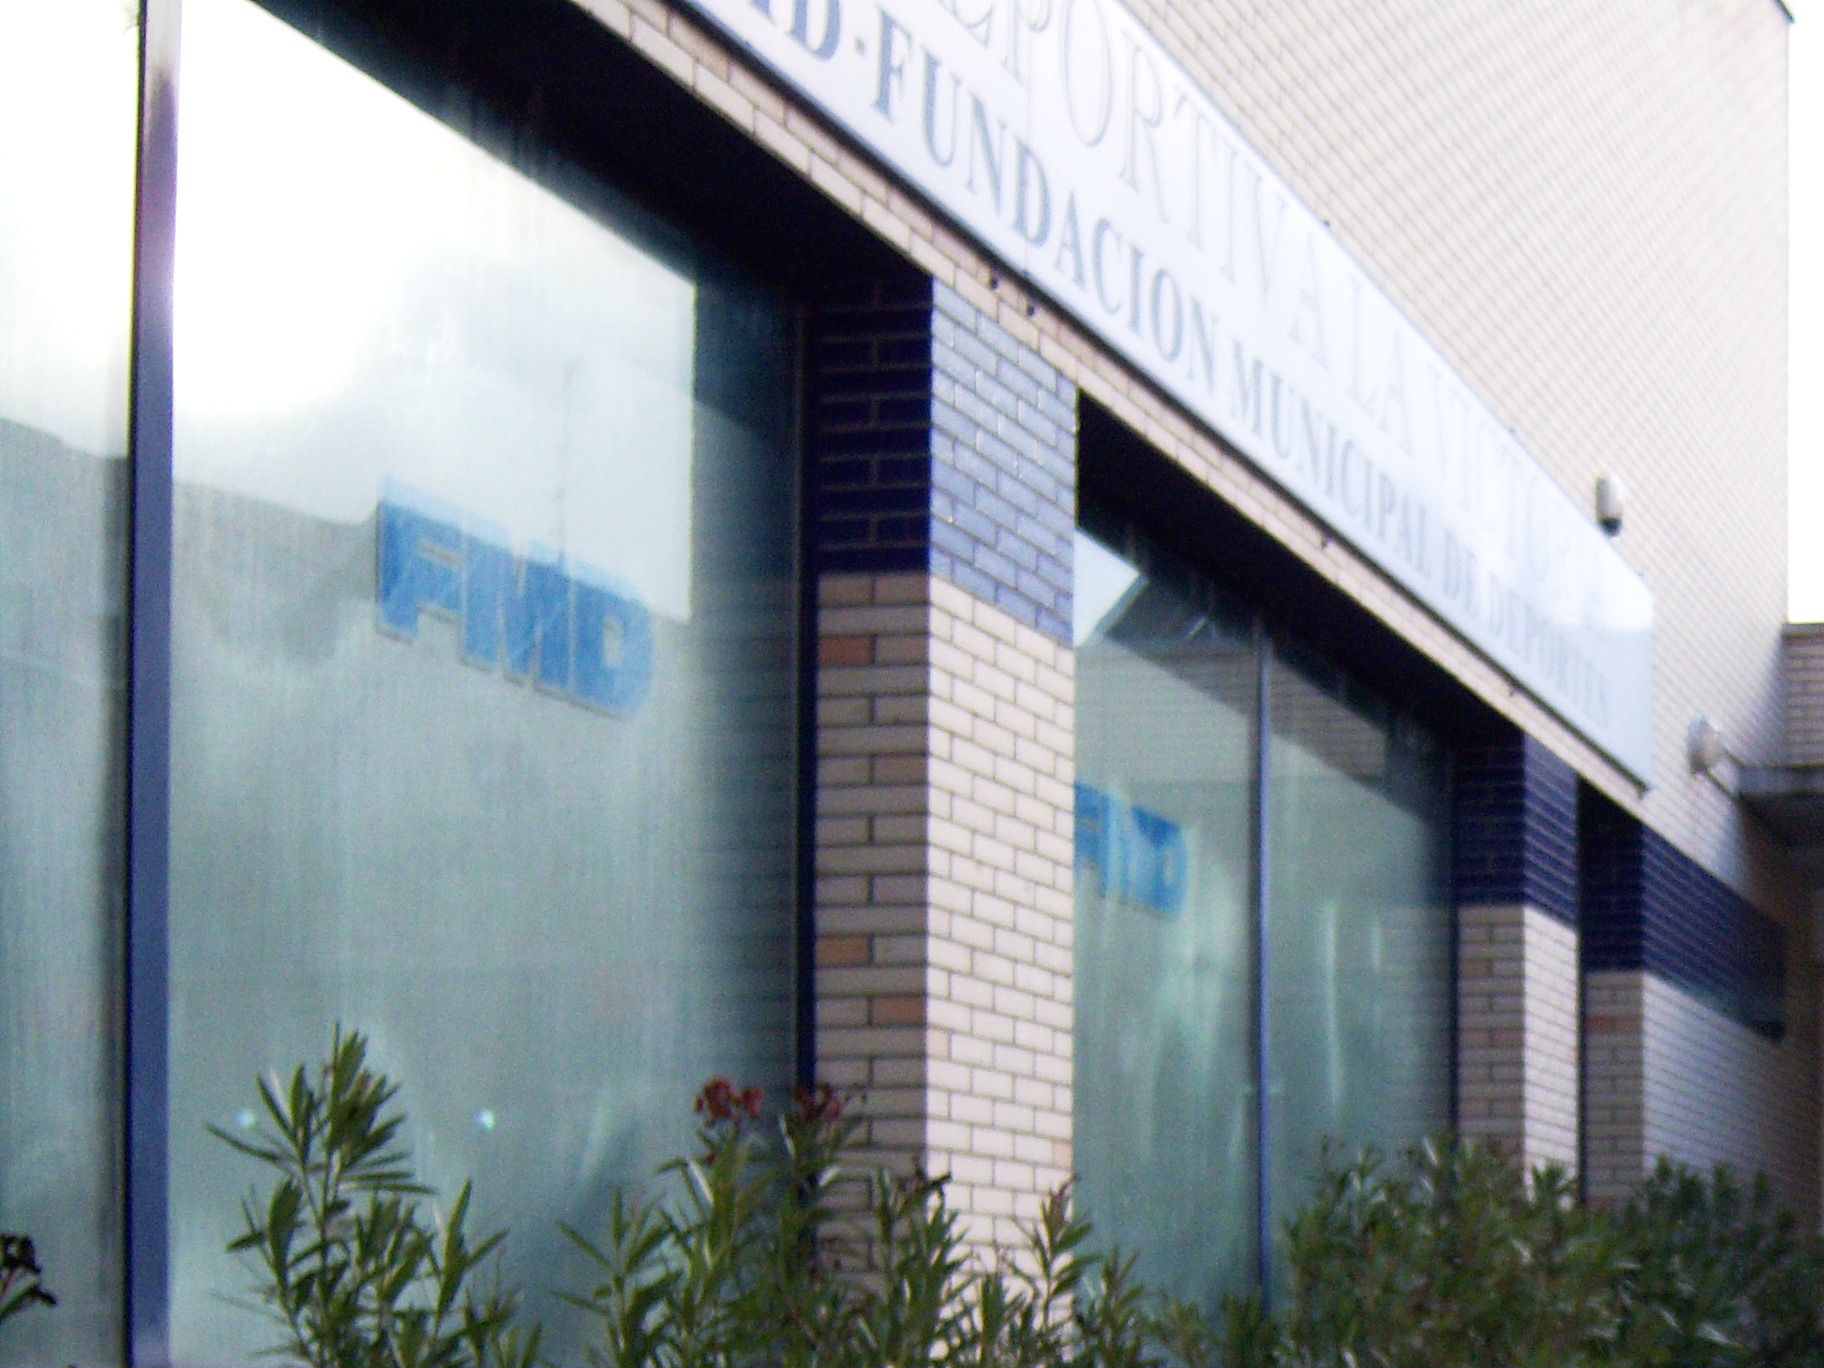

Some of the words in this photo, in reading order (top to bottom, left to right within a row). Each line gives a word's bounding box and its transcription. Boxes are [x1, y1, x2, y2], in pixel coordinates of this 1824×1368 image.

[872, 4, 1219, 393] FUNDACION
[1229, 334, 1430, 578] MUNICIPAL
[940, 0, 1330, 370] ORTIVA
